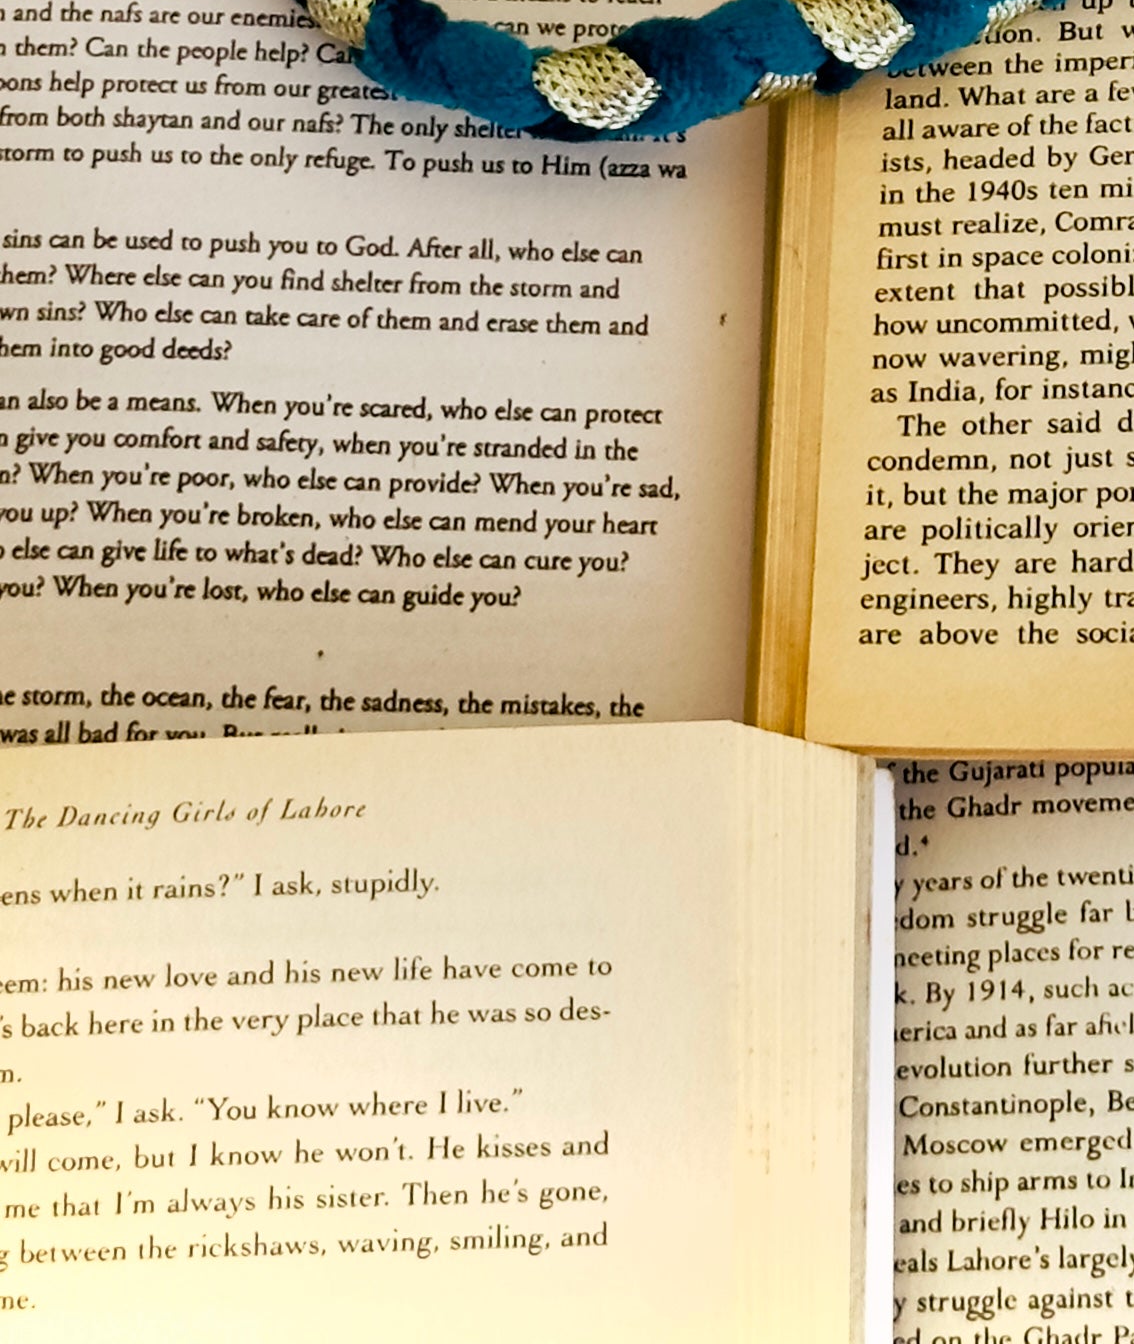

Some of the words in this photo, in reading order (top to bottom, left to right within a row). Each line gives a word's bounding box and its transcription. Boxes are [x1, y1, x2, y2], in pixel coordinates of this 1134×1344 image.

[879, 184, 905, 205] in
[915, 180, 956, 204] the
[968, 179, 1039, 202] 1940s
[1049, 182, 1089, 200] ten
[49, 336, 94, 359] into
[98, 336, 156, 366] good
[161, 336, 233, 361] deeds?
[27, 460, 94, 485] When
[100, 461, 172, 492] you're
[175, 471, 236, 494] poor,
[243, 465, 291, 490] who
[297, 466, 338, 491] else
[343, 476, 381, 492] can
[388, 469, 482, 500] provide?
[488, 471, 556, 496] When
[561, 473, 633, 503] you're
[638, 475, 681, 502] sad,
[865, 483, 893, 510] it,
[903, 481, 947, 506] but
[958, 480, 999, 506] the
[1007, 481, 1088, 510] major
[4, 806, 48, 831] The
[55, 803, 161, 831] Dancing
[172, 799, 236, 824] Girls
[245, 797, 274, 827] of
[279, 795, 367, 821] Lahore
[898, 796, 937, 822] the
[947, 792, 1023, 819] Ghadr
[49, 877, 118, 904] when
[127, 876, 143, 901] it
[253, 872, 263, 897] I
[271, 869, 322, 897] ask,
[330, 867, 440, 902] stupidly.
[925, 981, 956, 1013] By
[968, 978, 1035, 1005] 1914,
[1043, 974, 1099, 1000] such
[898, 1208, 943, 1235] and
[950, 1206, 1031, 1241] briefly
[1040, 1204, 1096, 1231] Hilo
[1103, 1207, 1128, 1231] in
